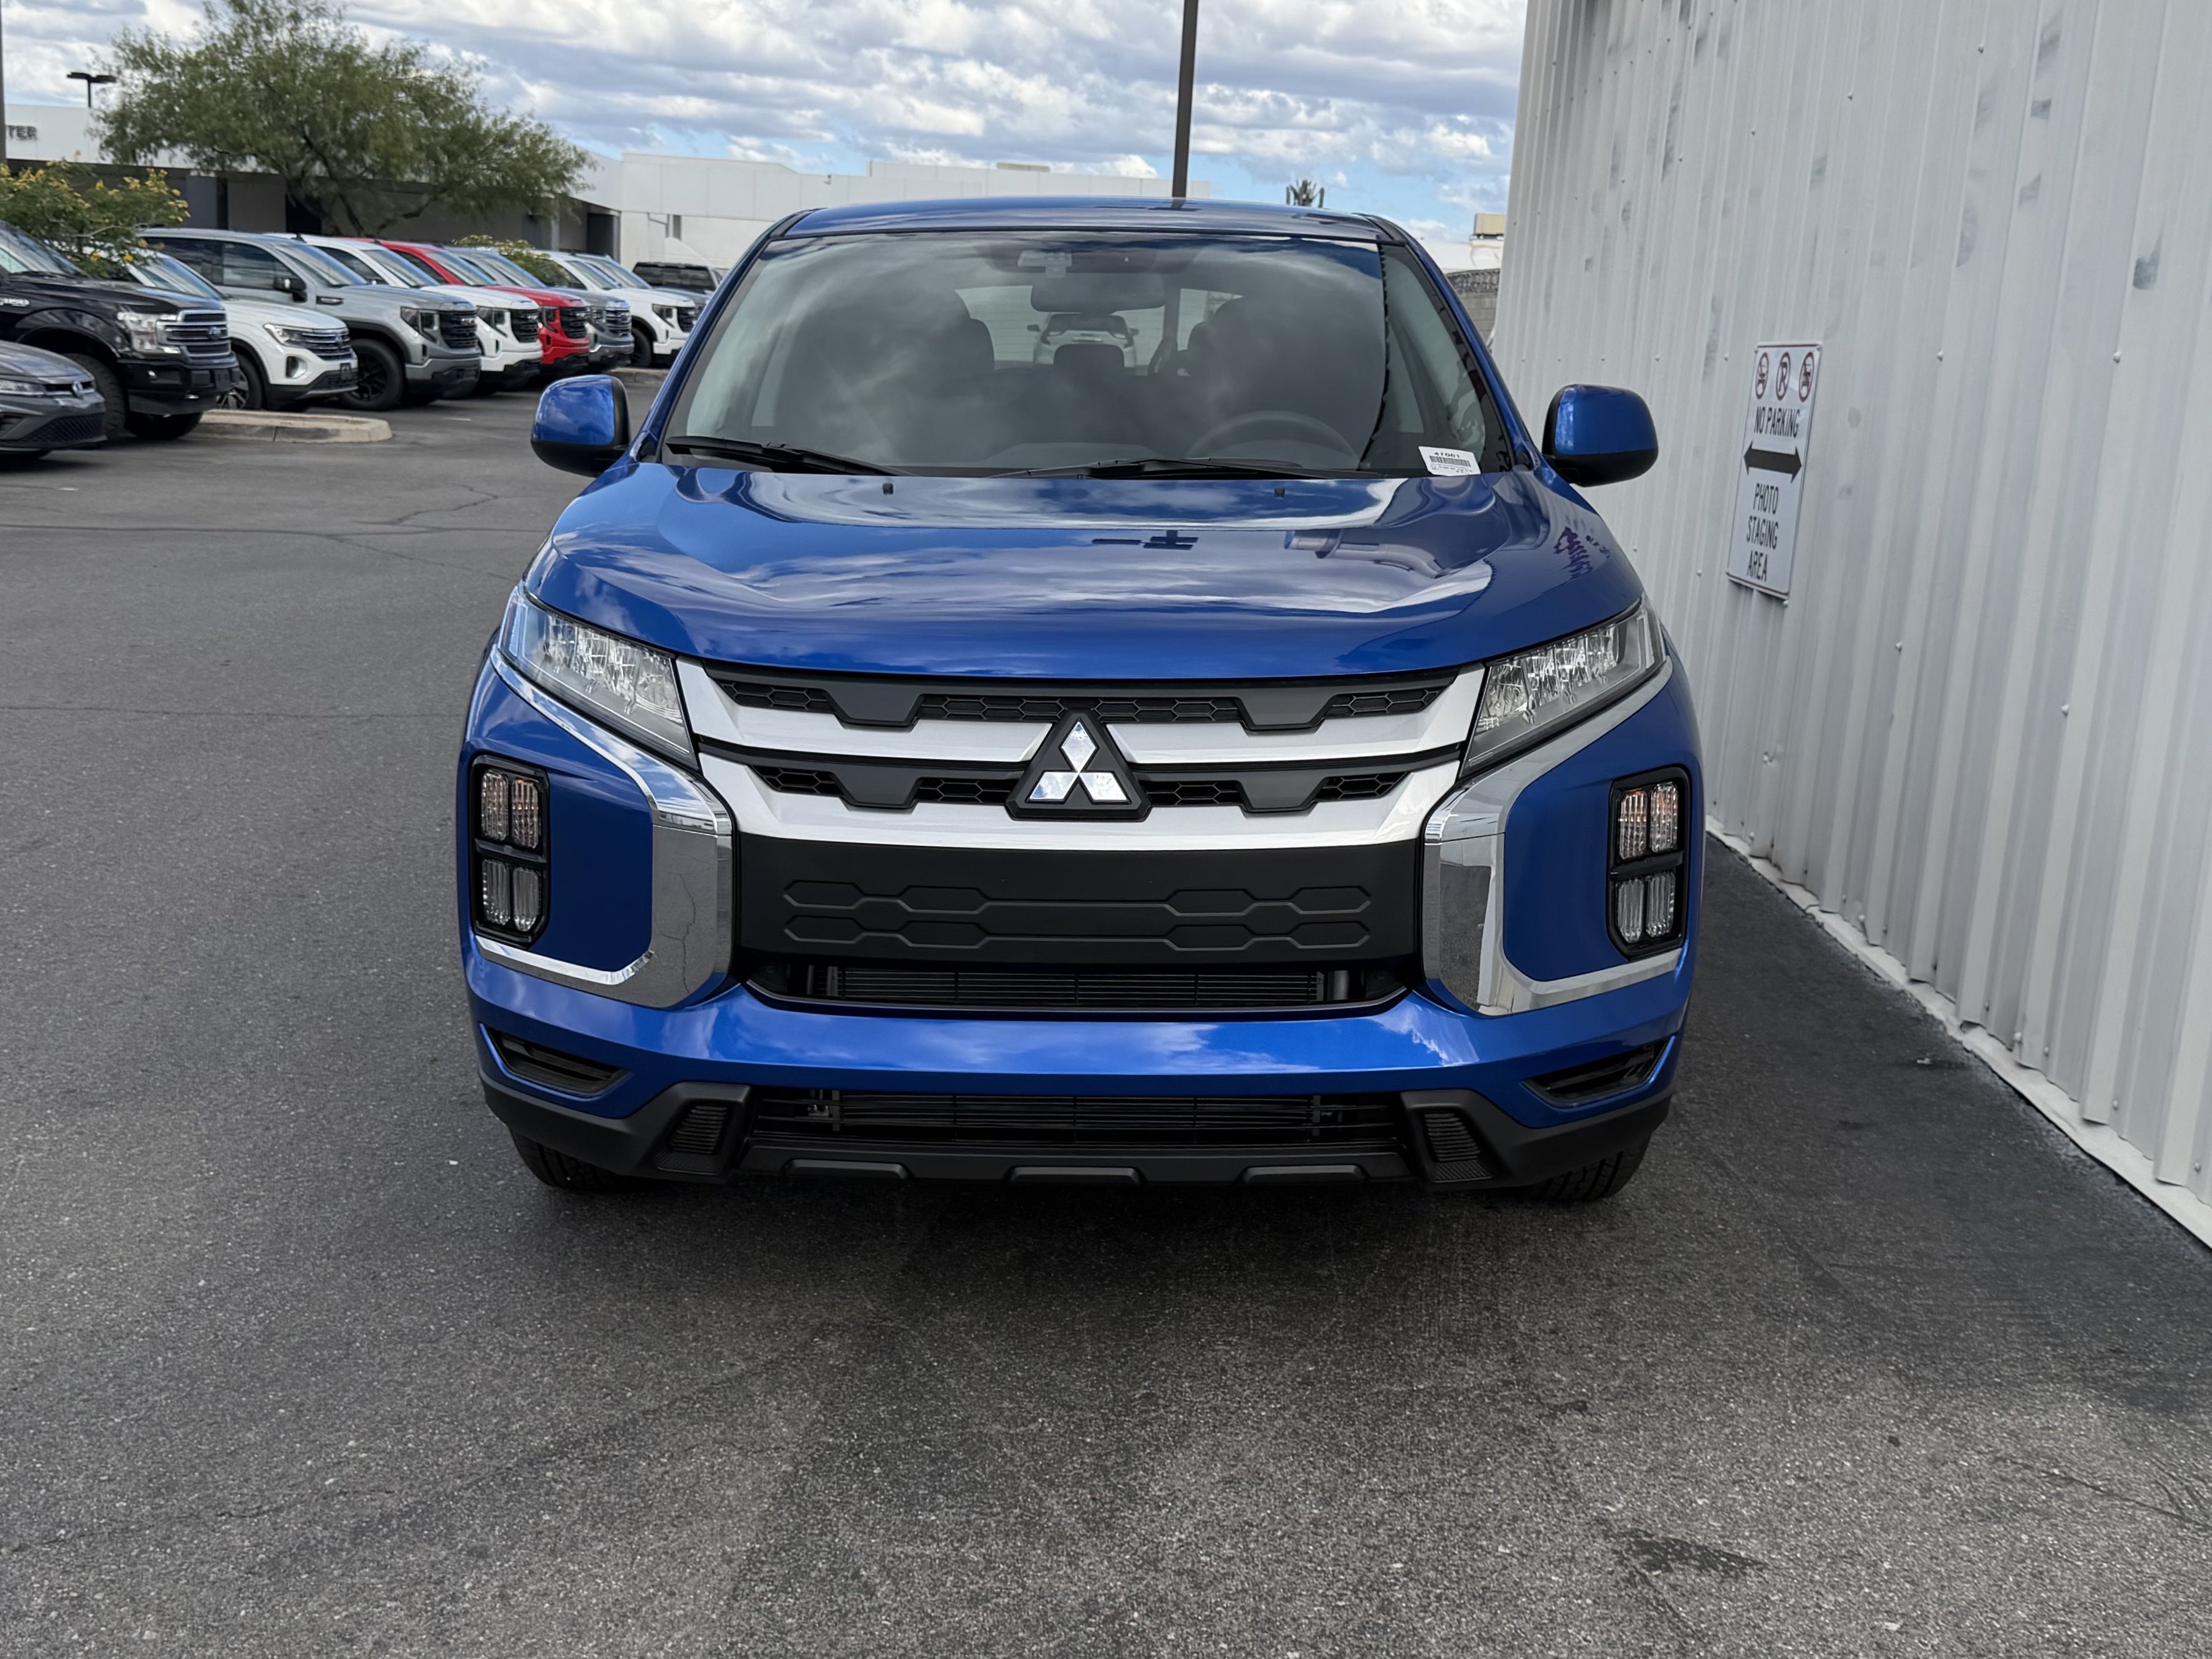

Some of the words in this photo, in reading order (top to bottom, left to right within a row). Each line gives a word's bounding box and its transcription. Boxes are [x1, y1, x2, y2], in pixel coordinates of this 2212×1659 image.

[1754, 406, 1765, 434] NO
[1765, 406, 1800, 438] PARKING
[1753, 483, 1779, 515] PHOTO
[1746, 515, 1779, 551] STAGING
[1746, 549, 1768, 582] AREA
